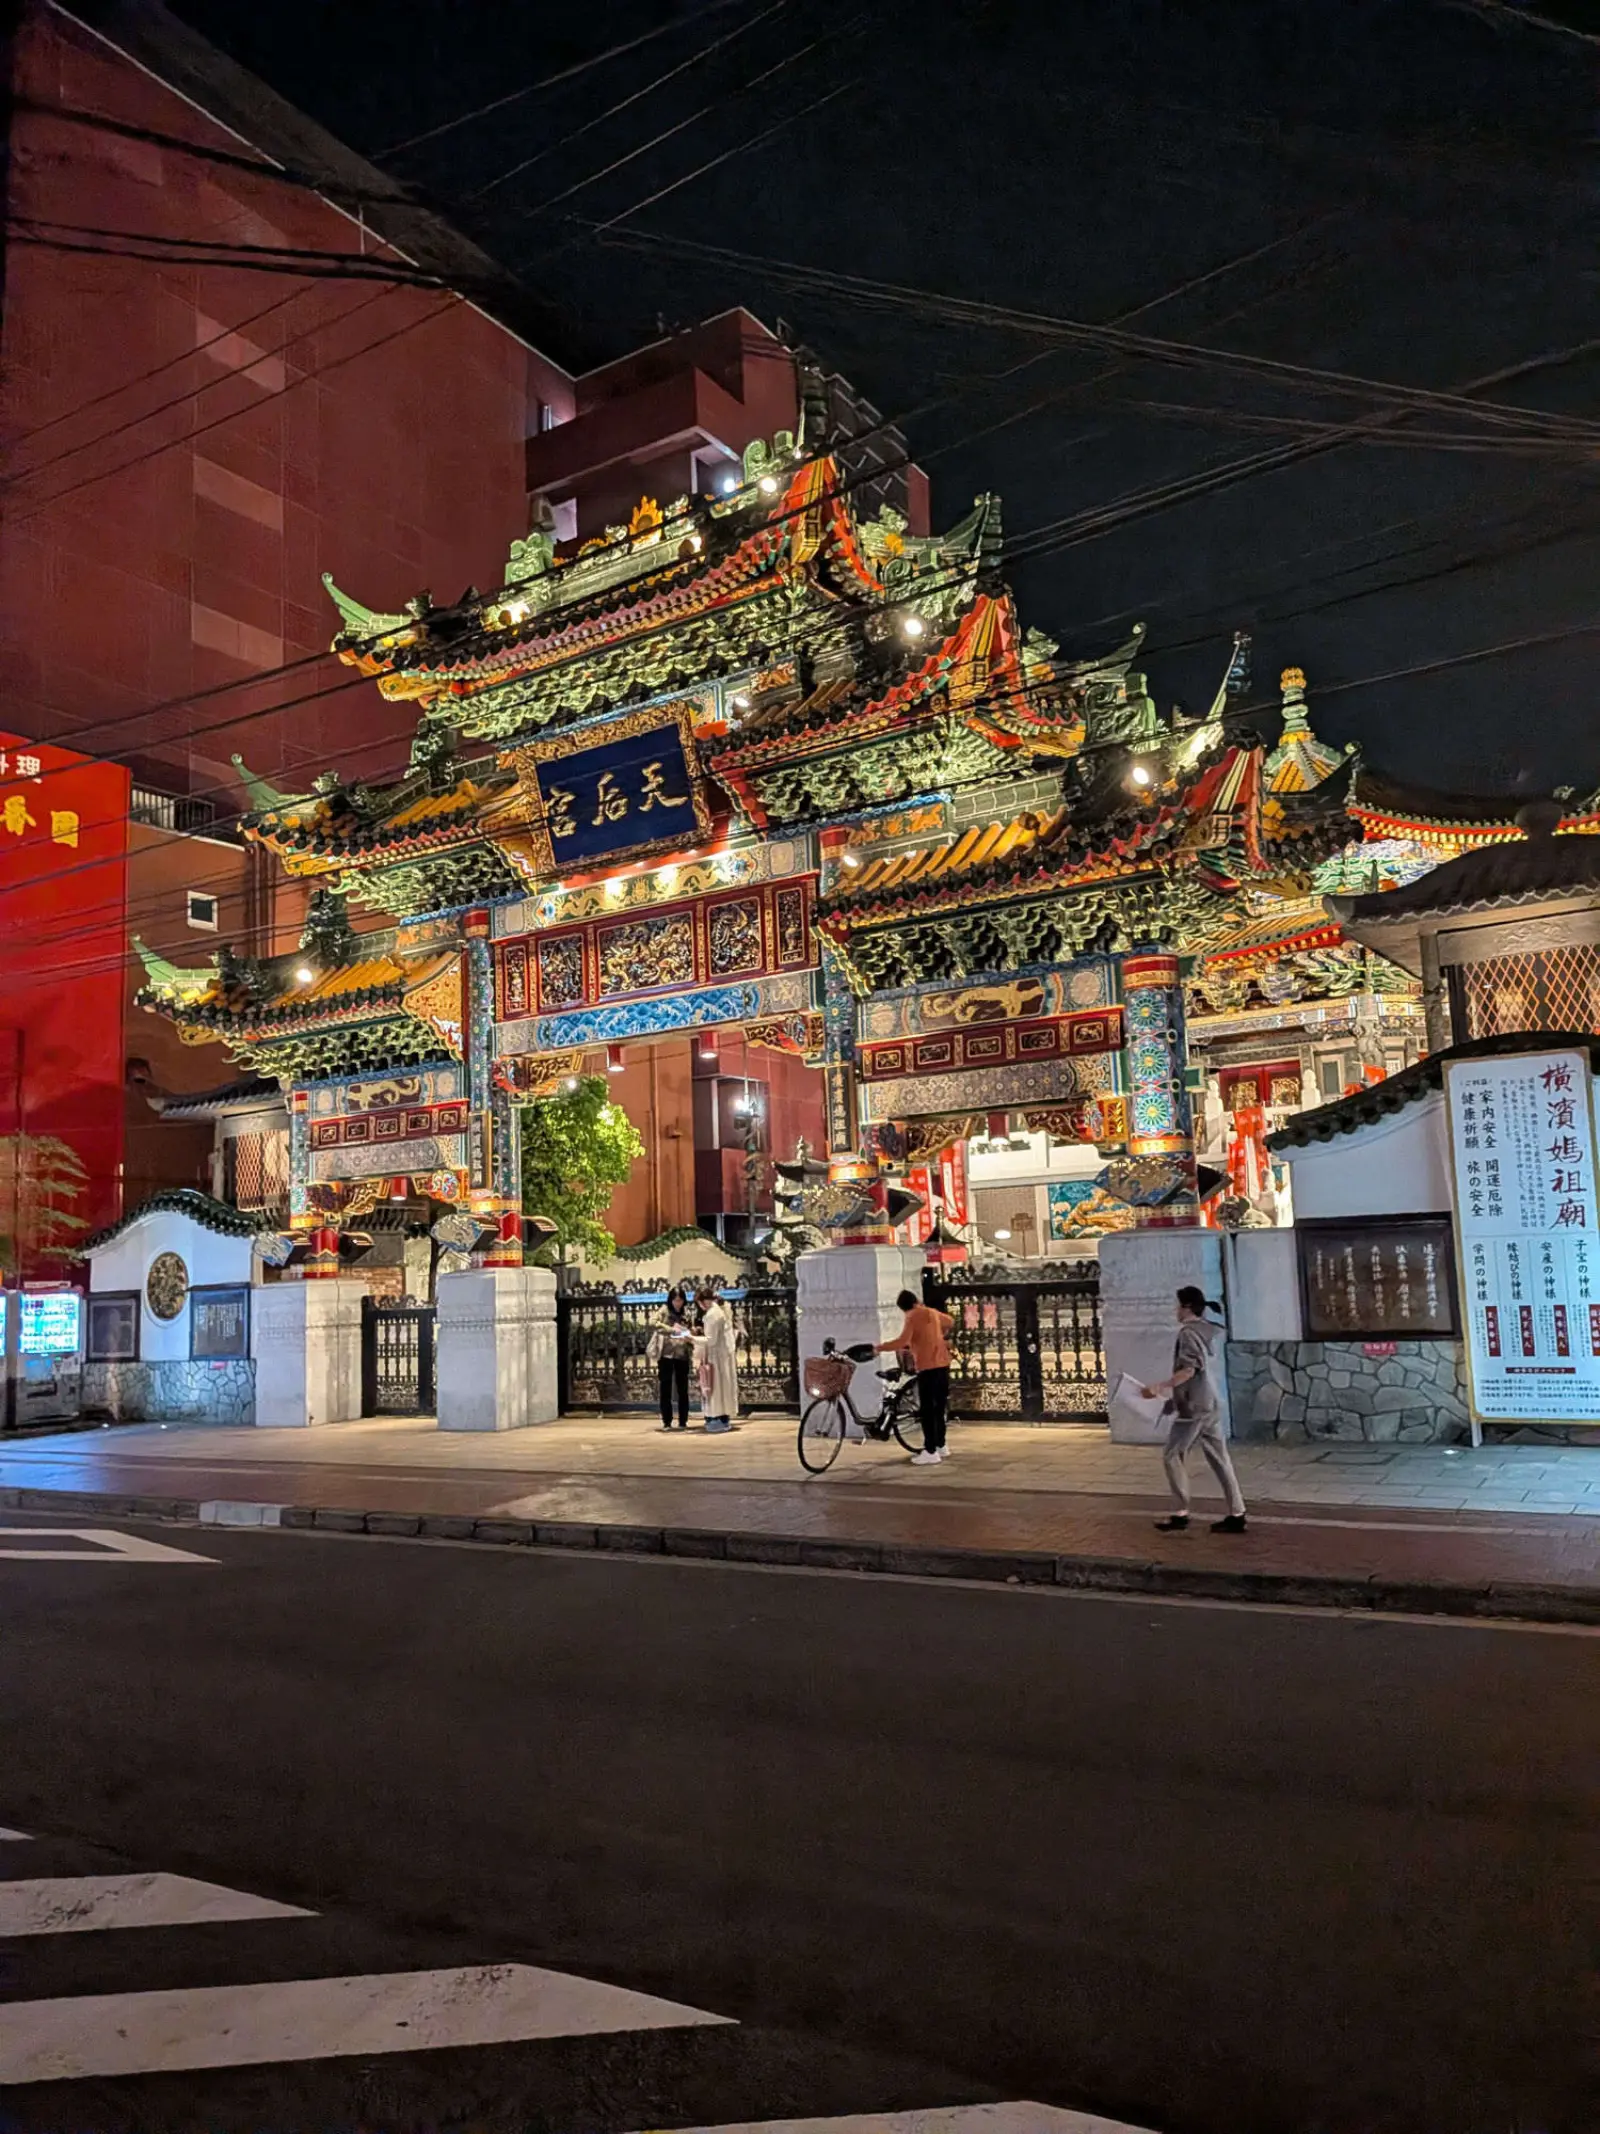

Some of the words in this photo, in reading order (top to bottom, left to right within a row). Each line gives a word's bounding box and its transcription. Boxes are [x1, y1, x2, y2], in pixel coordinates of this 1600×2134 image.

[1461, 1091, 1480, 1149] 健康祈願
[1479, 1090, 1497, 1149] 家内安全
[1467, 1160, 1485, 1217] 旅の安全
[1485, 1158, 1504, 1217] 開運厄除
[1472, 1243, 1488, 1301] 学問の神様
[1506, 1242, 1523, 1300] 縁結びの神様
[1540, 1241, 1557, 1300] 安産の神様
[1575, 1239, 1591, 1299] 子宝の神様
